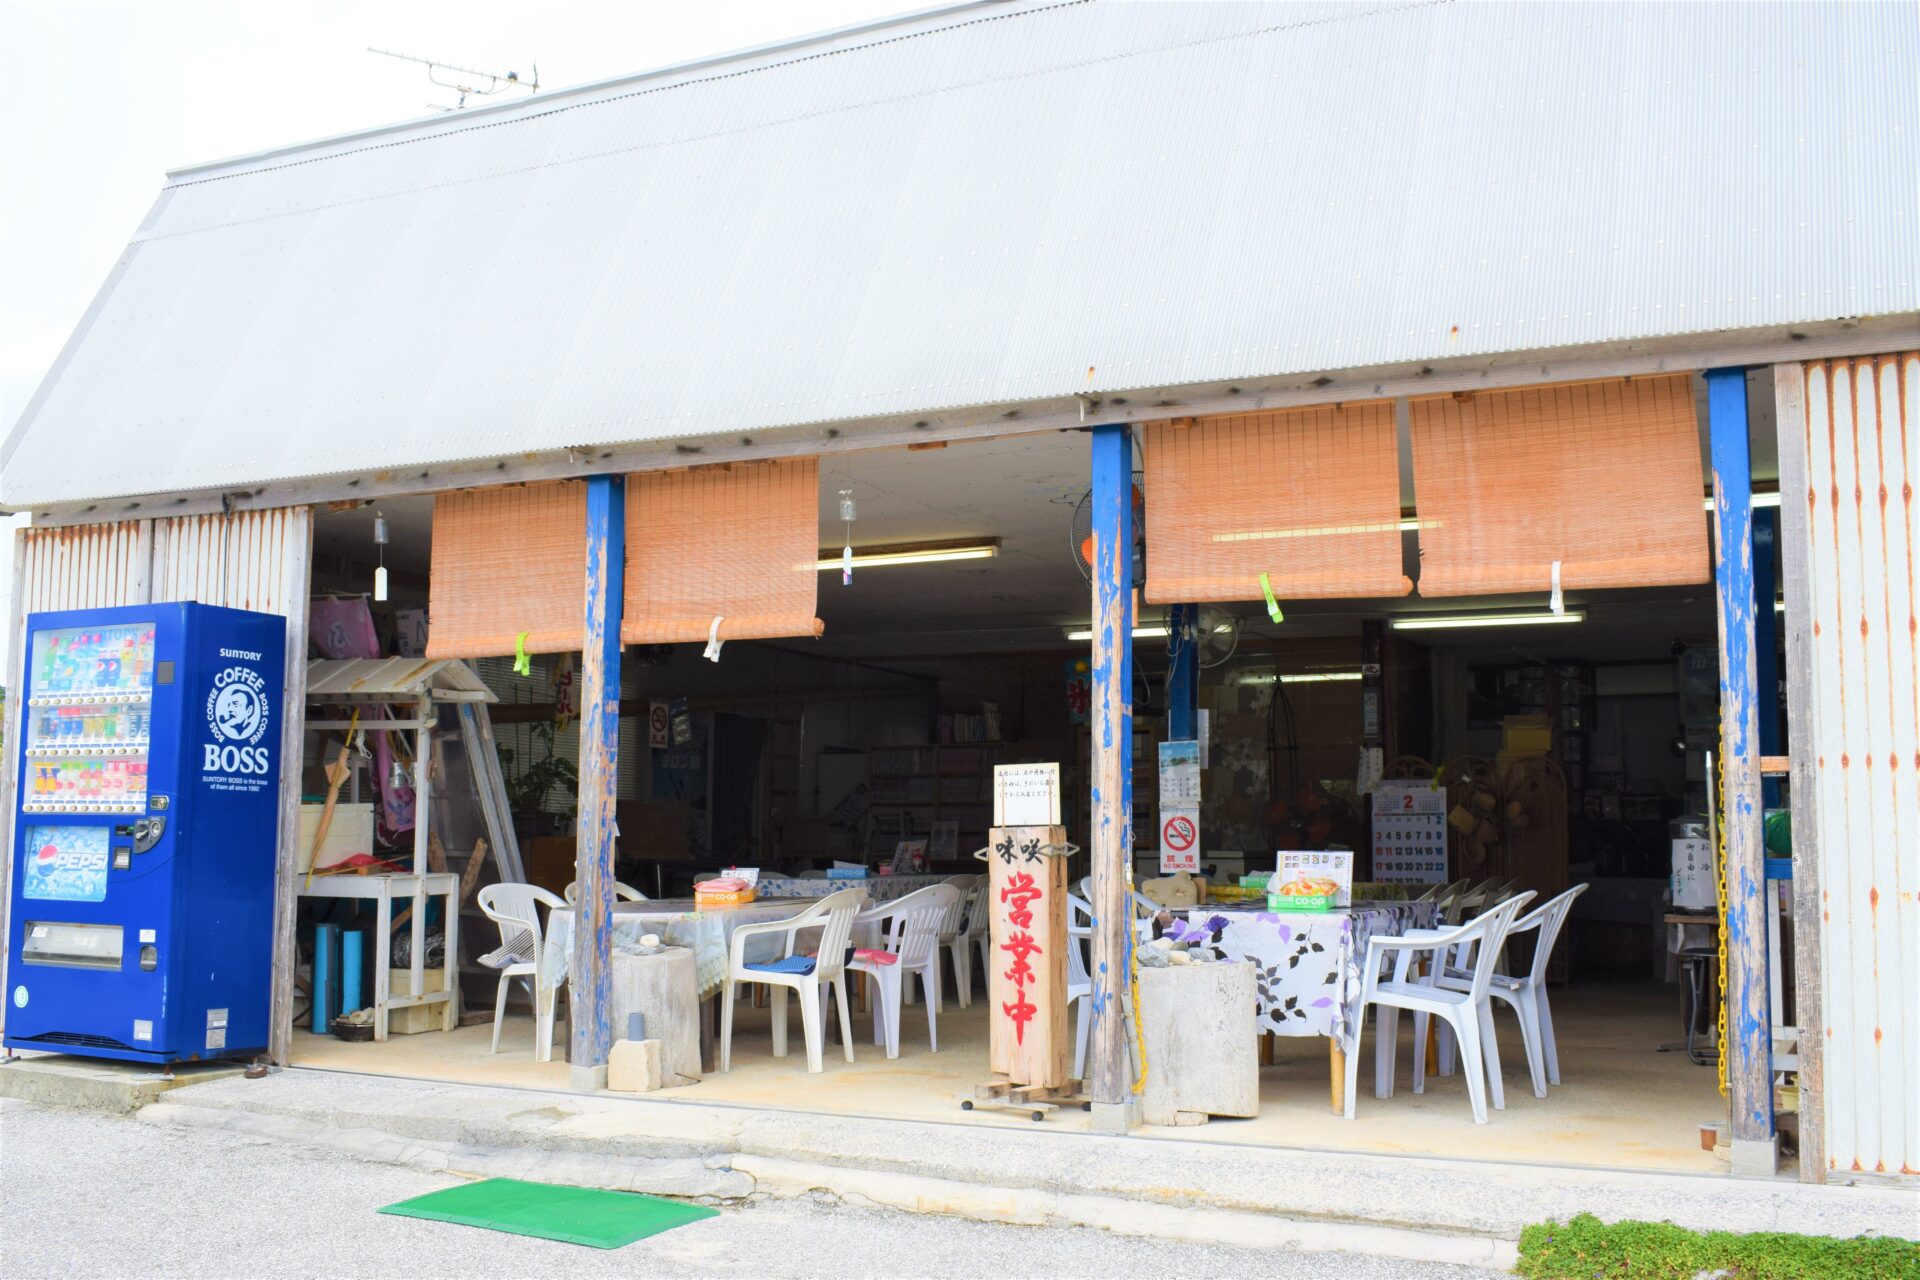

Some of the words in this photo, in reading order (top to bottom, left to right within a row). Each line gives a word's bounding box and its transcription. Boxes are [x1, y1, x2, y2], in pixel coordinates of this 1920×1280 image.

[214, 667, 265, 692] COFFEE
[206, 687, 219, 721] COFFEE
[259, 692, 269, 716] BOSS
[209, 721, 225, 743] BOSS
[249, 717, 268, 745] COFFEE
[203, 744, 269, 774] BOSS
[1403, 795, 1413, 809] 2
[1436, 816, 1442, 824] 2
[1376, 832, 1381, 840] 3
[1386, 832, 1391, 840] 4
[1396, 832, 1401, 840] 5
[1405, 832, 1411, 840] 6
[1416, 832, 1421, 840] 7
[1426, 832, 1431, 840] 8
[1436, 832, 1442, 840] 9
[55, 852, 107, 871] PEPSI
[1376, 847, 1383, 856] 10
[1385, 847, 1392, 856] 11
[1395, 847, 1403, 856] 12
[1405, 847, 1413, 856] 13
[1415, 847, 1423, 856] 14
[1425, 847, 1433, 856] 15
[1435, 847, 1443, 856] 16
[1376, 862, 1383, 871] 17
[1385, 862, 1393, 871] 18
[1395, 862, 1403, 871] 19
[1404, 862, 1414, 871] 20
[1415, 862, 1423, 871] 21
[1425, 862, 1433, 871] 22
[1435, 862, 1444, 871] 23
[1001, 870, 1043, 1047] 営業中
